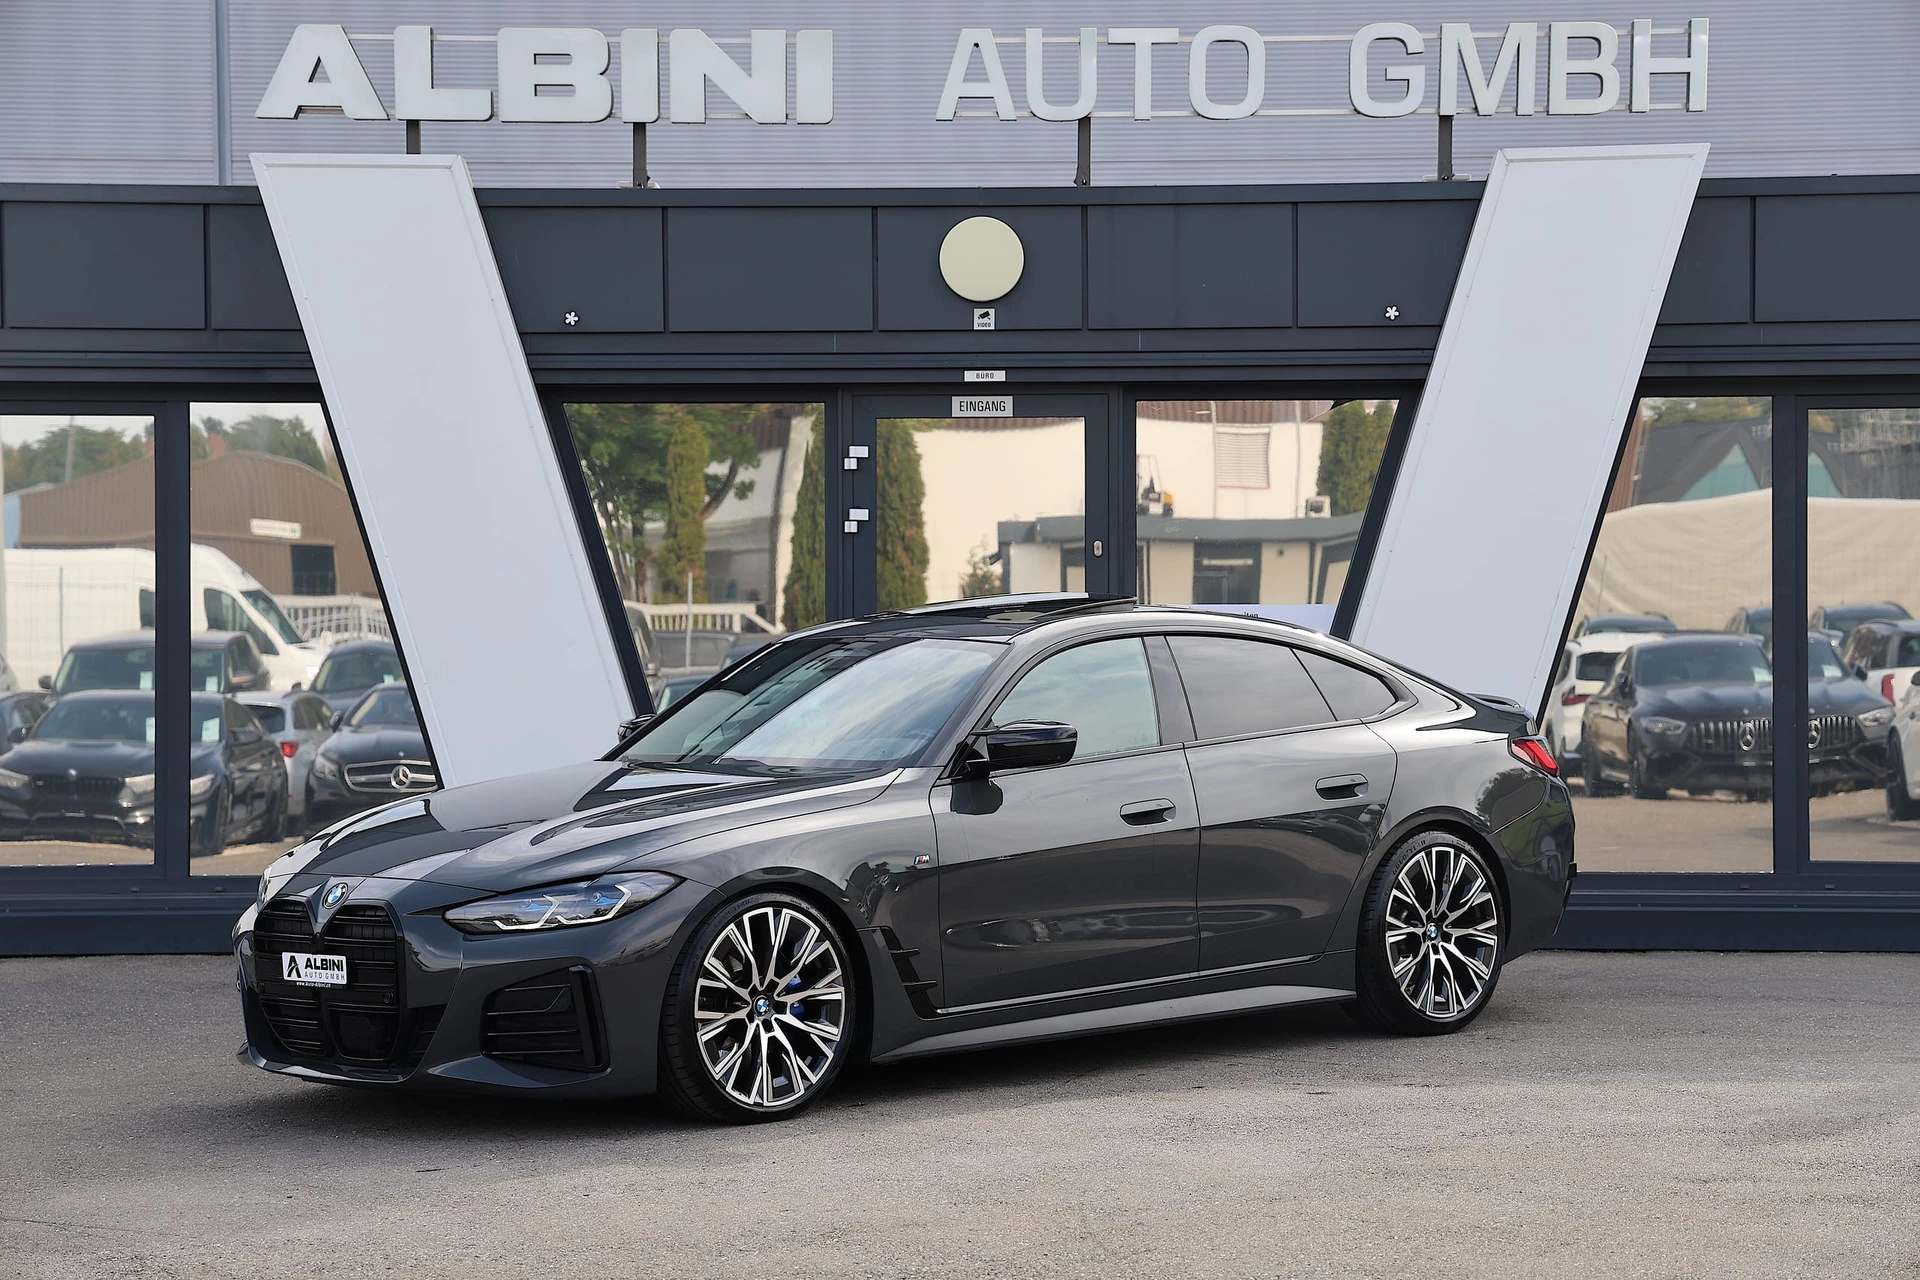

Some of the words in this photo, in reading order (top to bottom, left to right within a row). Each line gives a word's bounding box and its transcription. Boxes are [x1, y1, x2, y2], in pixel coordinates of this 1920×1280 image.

[256, 24, 834, 125] ALBINI
[935, 25, 1266, 122] AUTO
[1349, 17, 1710, 118] GMBH
[975, 371, 995, 379] BÜRO
[959, 400, 1006, 412] EINGANG
[304, 957, 344, 972] ALBINI
[304, 971, 323, 979] AUTO
[325, 972, 345, 980] GMBH
